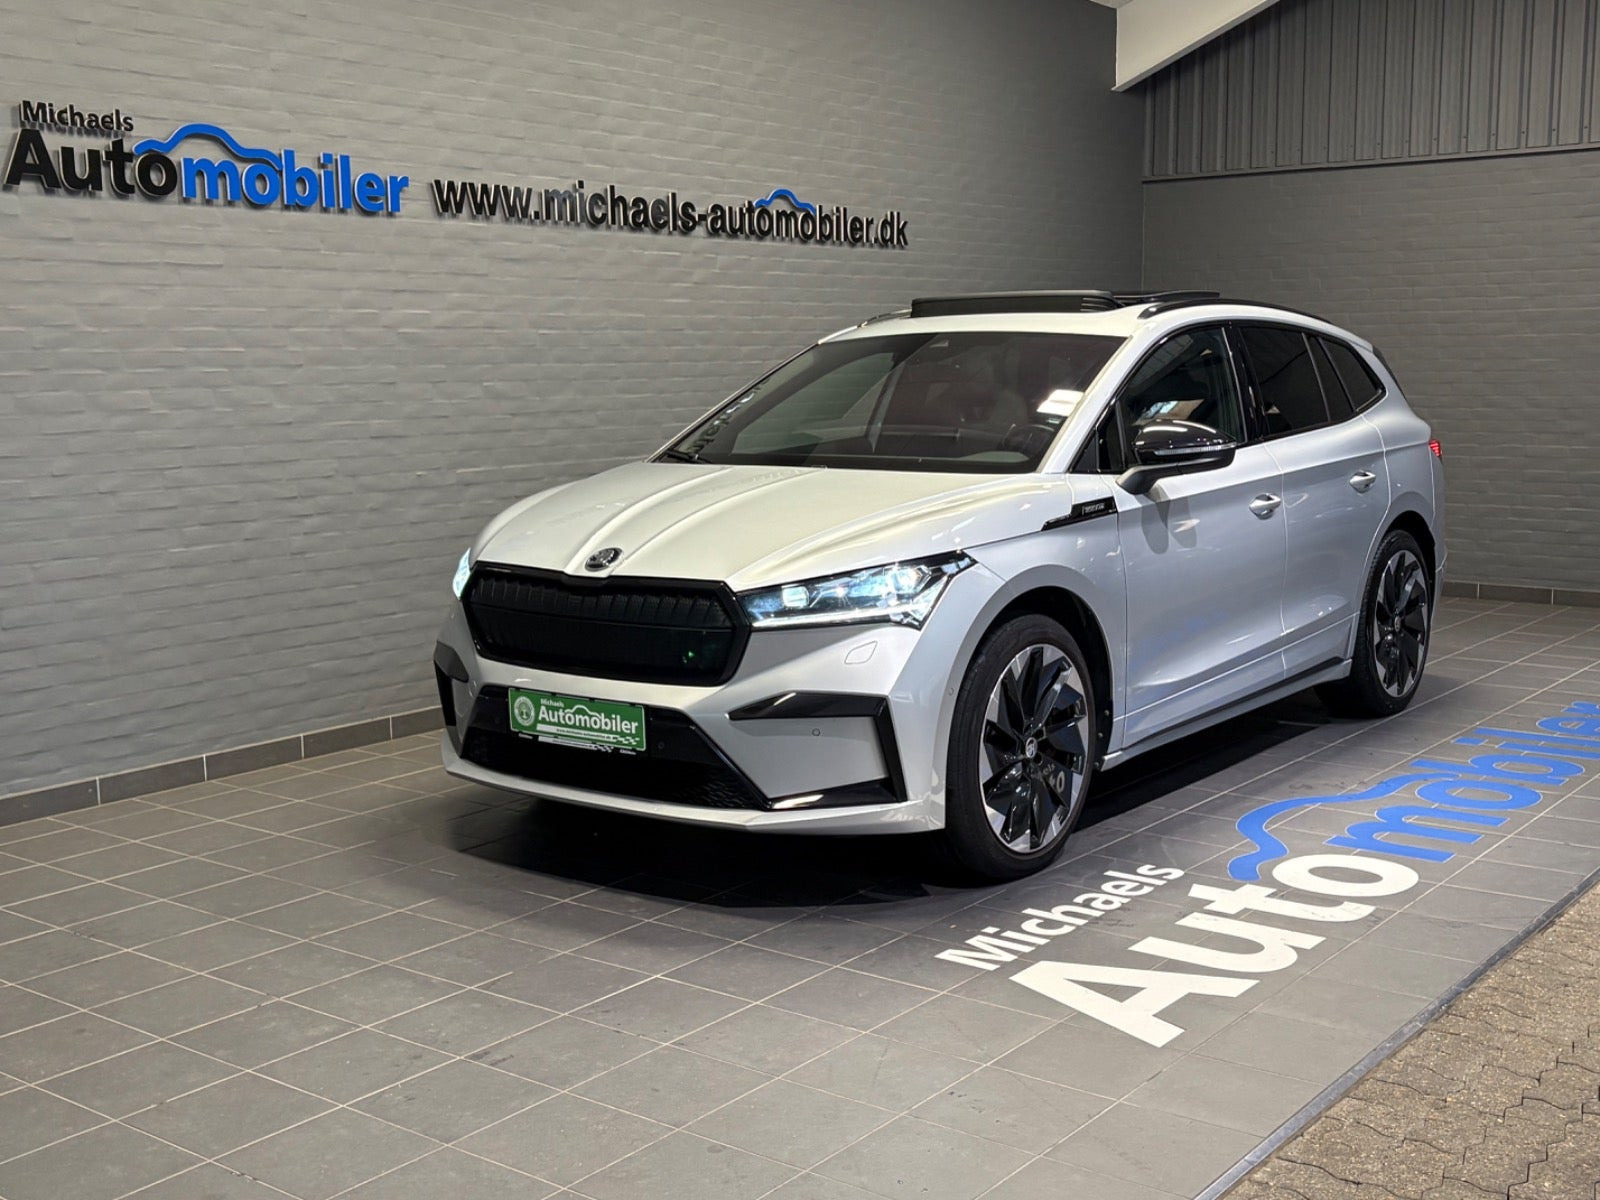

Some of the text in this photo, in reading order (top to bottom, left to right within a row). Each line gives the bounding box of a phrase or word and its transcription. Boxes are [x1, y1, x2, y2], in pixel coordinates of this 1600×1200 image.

[20, 100, 134, 132] Michaels
[4, 128, 410, 213] Automobiler
[431, 179, 908, 247] www.michaels-automobiler.dk
[538, 705, 639, 734] Automobiler
[933, 864, 1185, 972] Michaels
